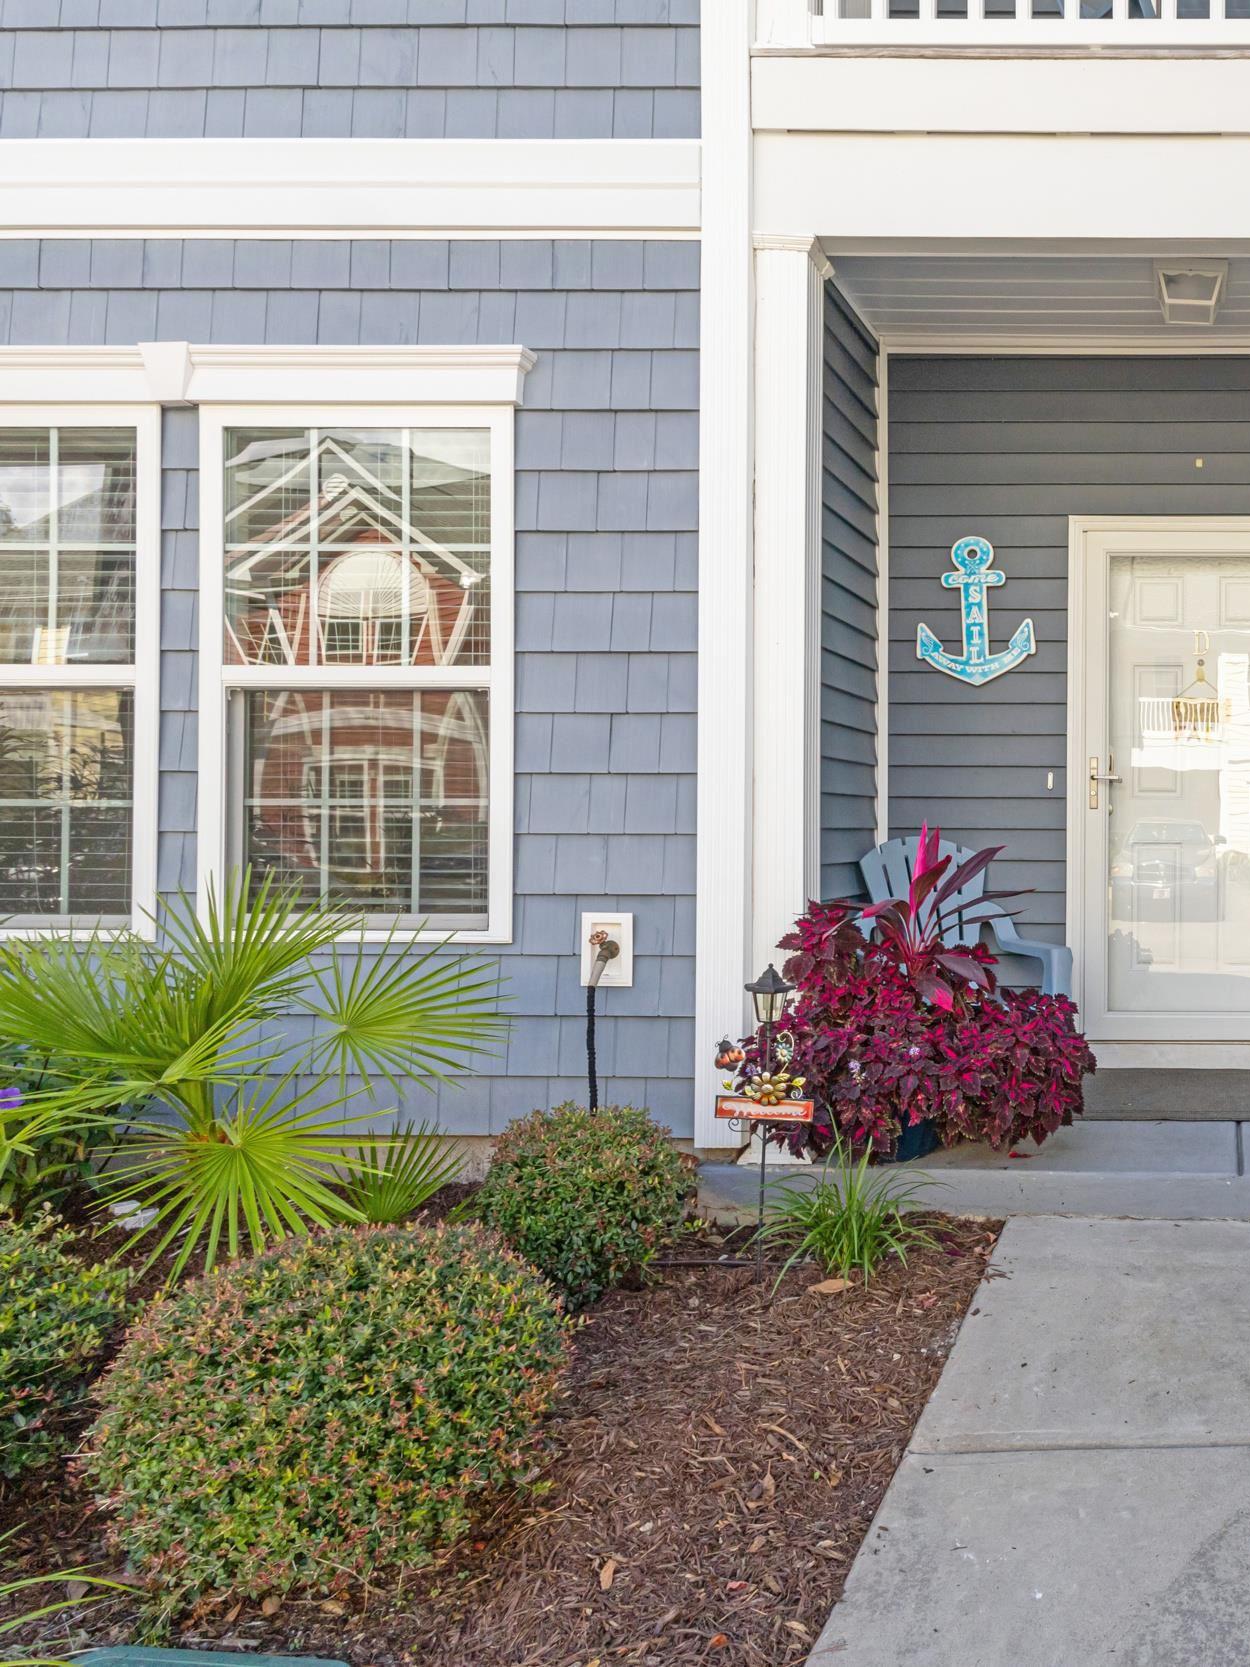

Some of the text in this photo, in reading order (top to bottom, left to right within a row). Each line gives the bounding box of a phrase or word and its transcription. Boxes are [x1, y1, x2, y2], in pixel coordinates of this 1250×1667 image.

[949, 574, 999, 584] come
[966, 586, 984, 664] SAIL
[1192, 630, 1209, 655] D
